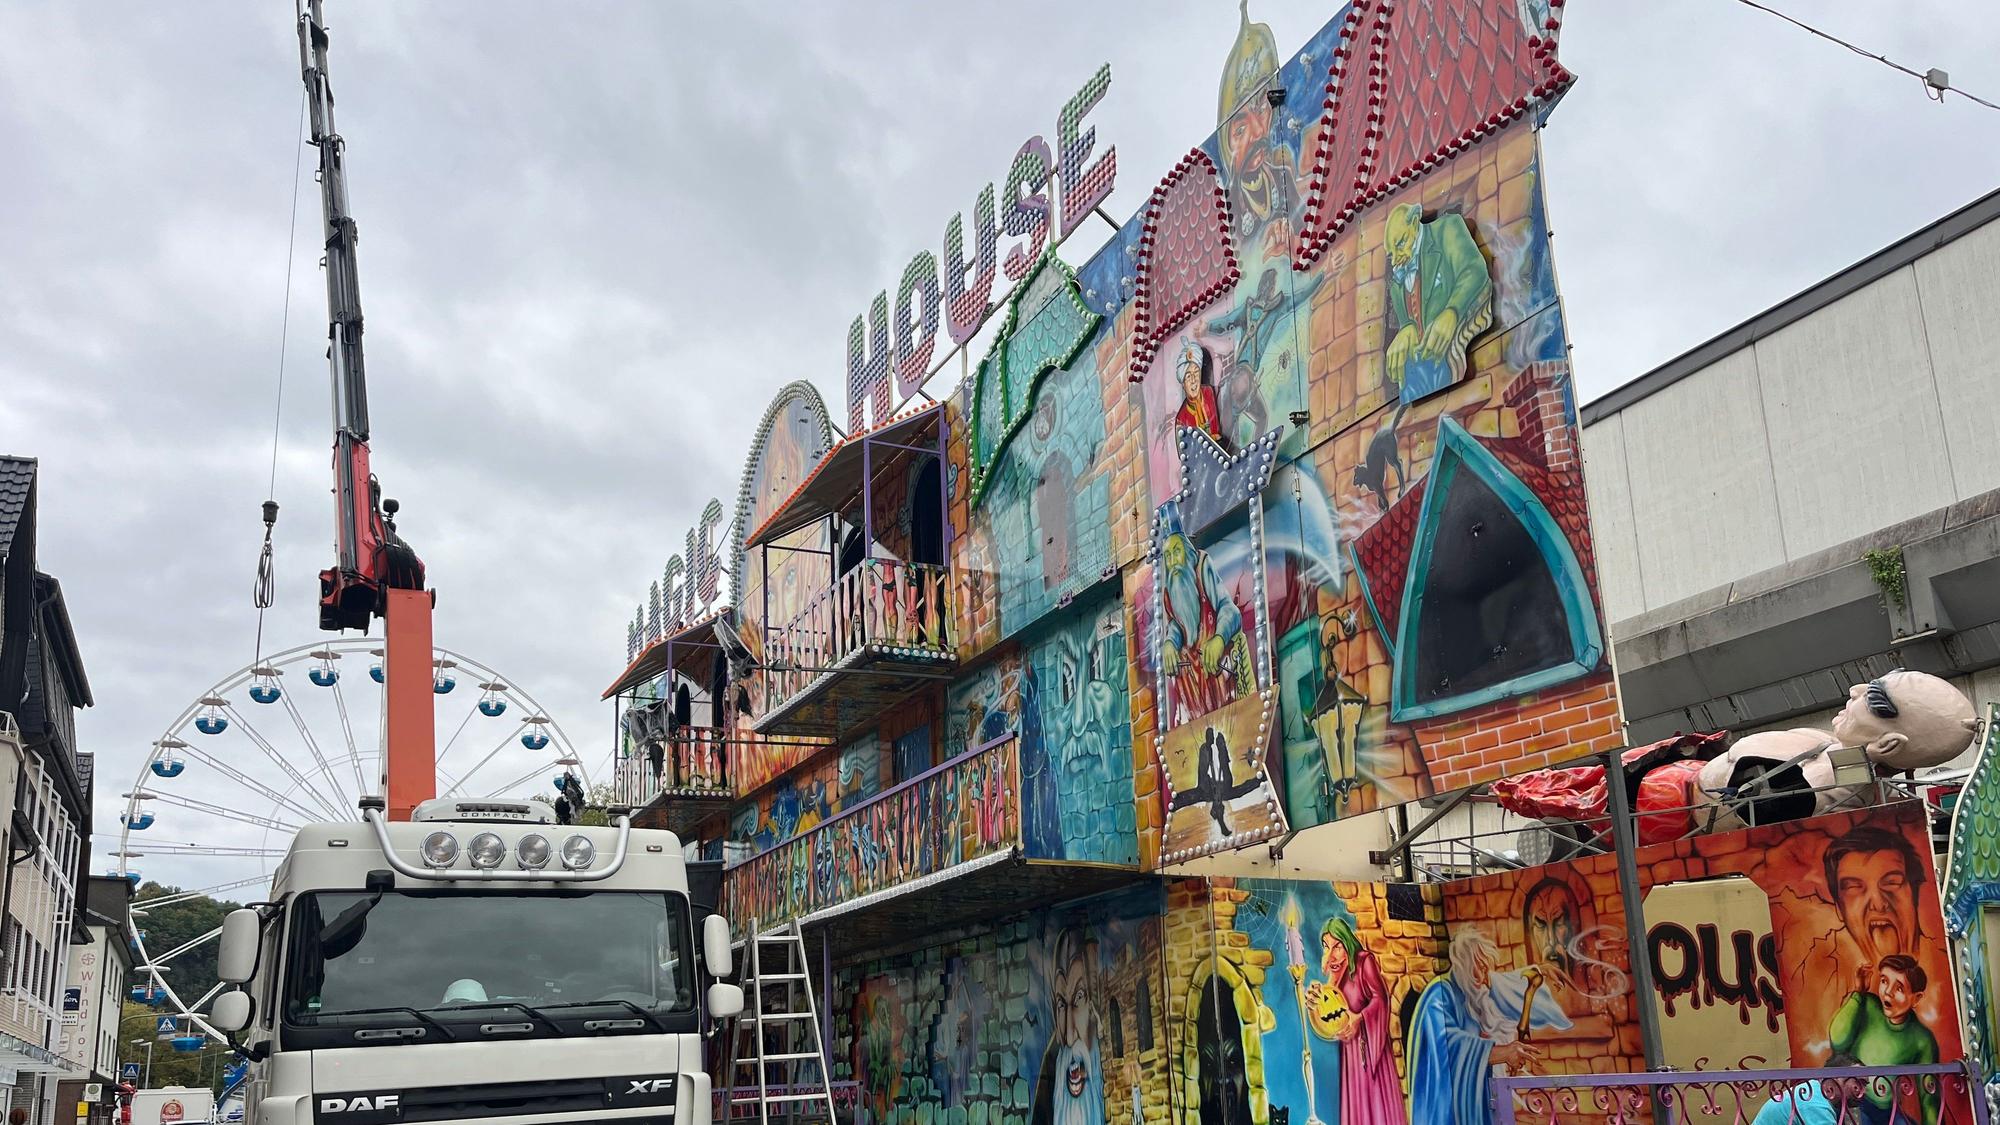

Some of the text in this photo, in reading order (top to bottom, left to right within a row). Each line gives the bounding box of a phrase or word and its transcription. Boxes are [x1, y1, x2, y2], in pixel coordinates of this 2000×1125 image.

[847, 62, 1117, 437] HOUSE
[624, 1078, 673, 1095] XF
[320, 1095, 399, 1113] DAF
